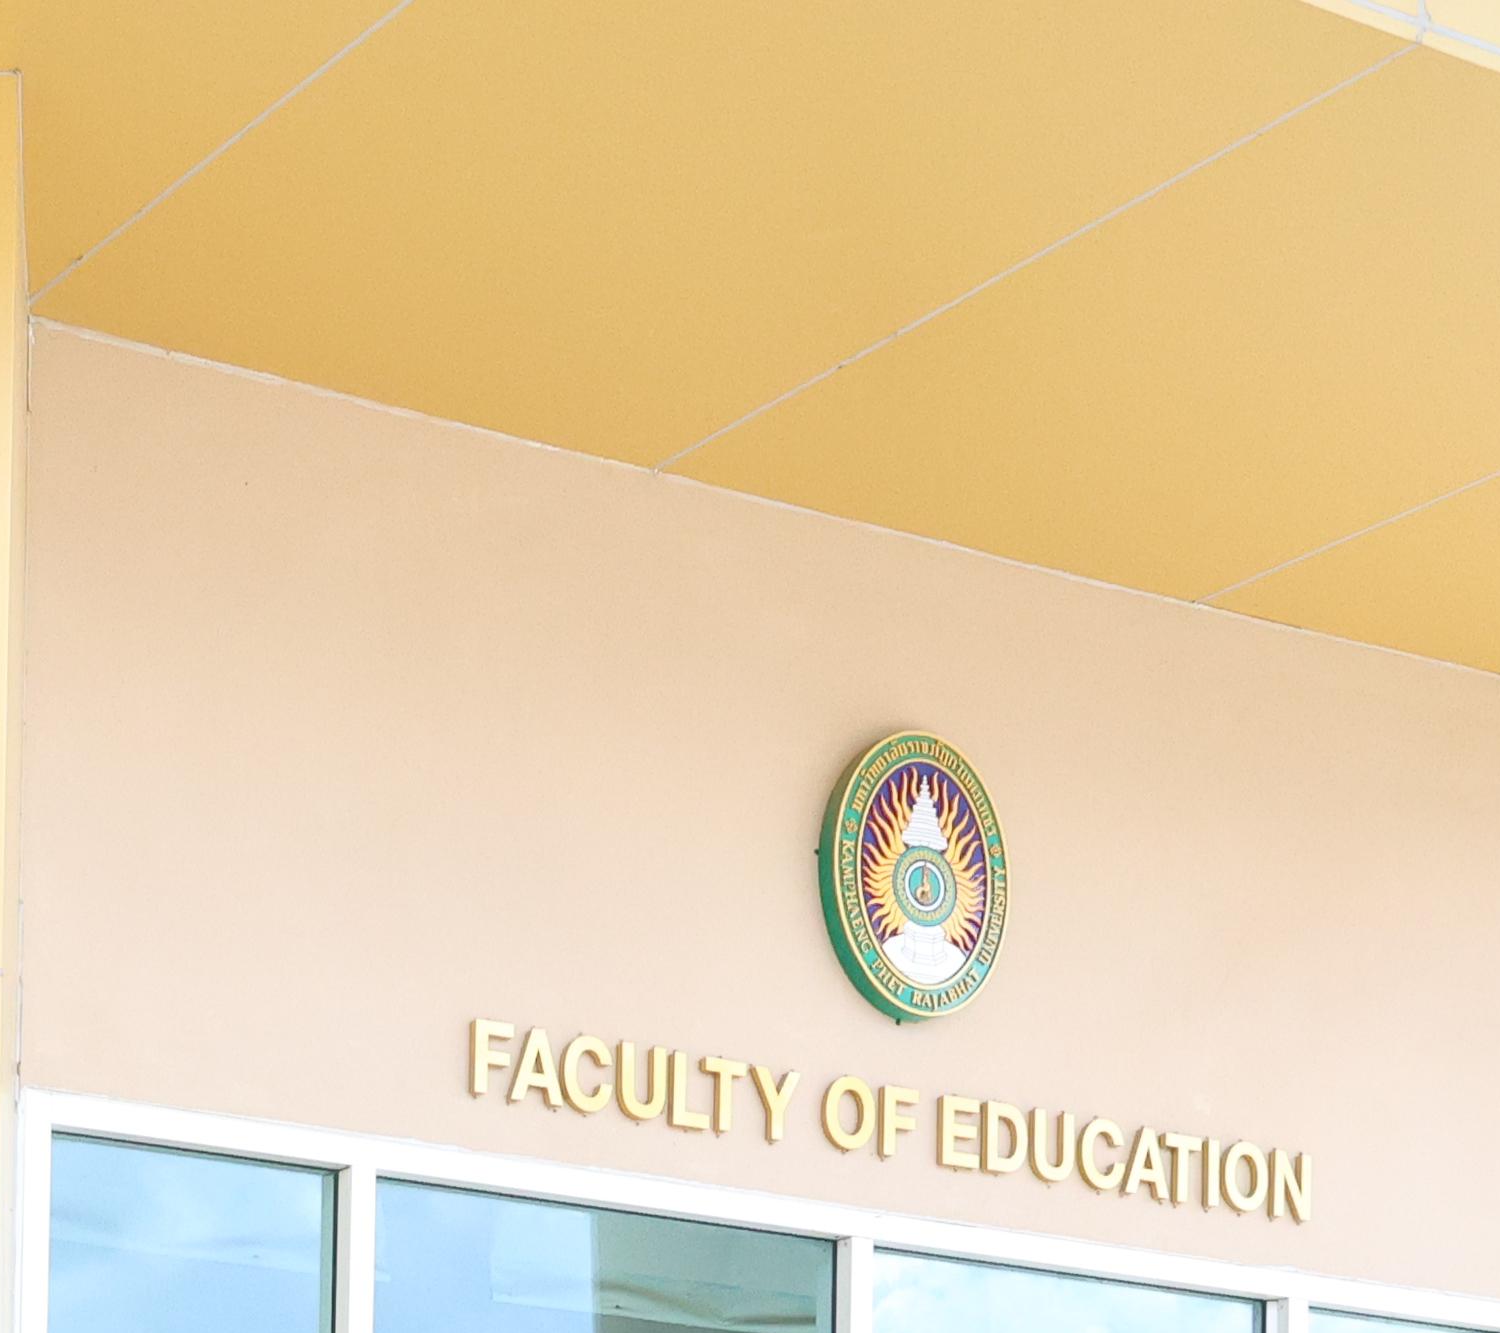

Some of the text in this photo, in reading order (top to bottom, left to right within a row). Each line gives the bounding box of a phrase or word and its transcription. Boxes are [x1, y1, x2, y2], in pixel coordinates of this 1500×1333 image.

[841, 838, 1006, 1013] KAMPHAENG PHET RAJABHAT UNIVERSITY
[468, 1018, 1313, 1224] FACULTY OF EDUCATION
